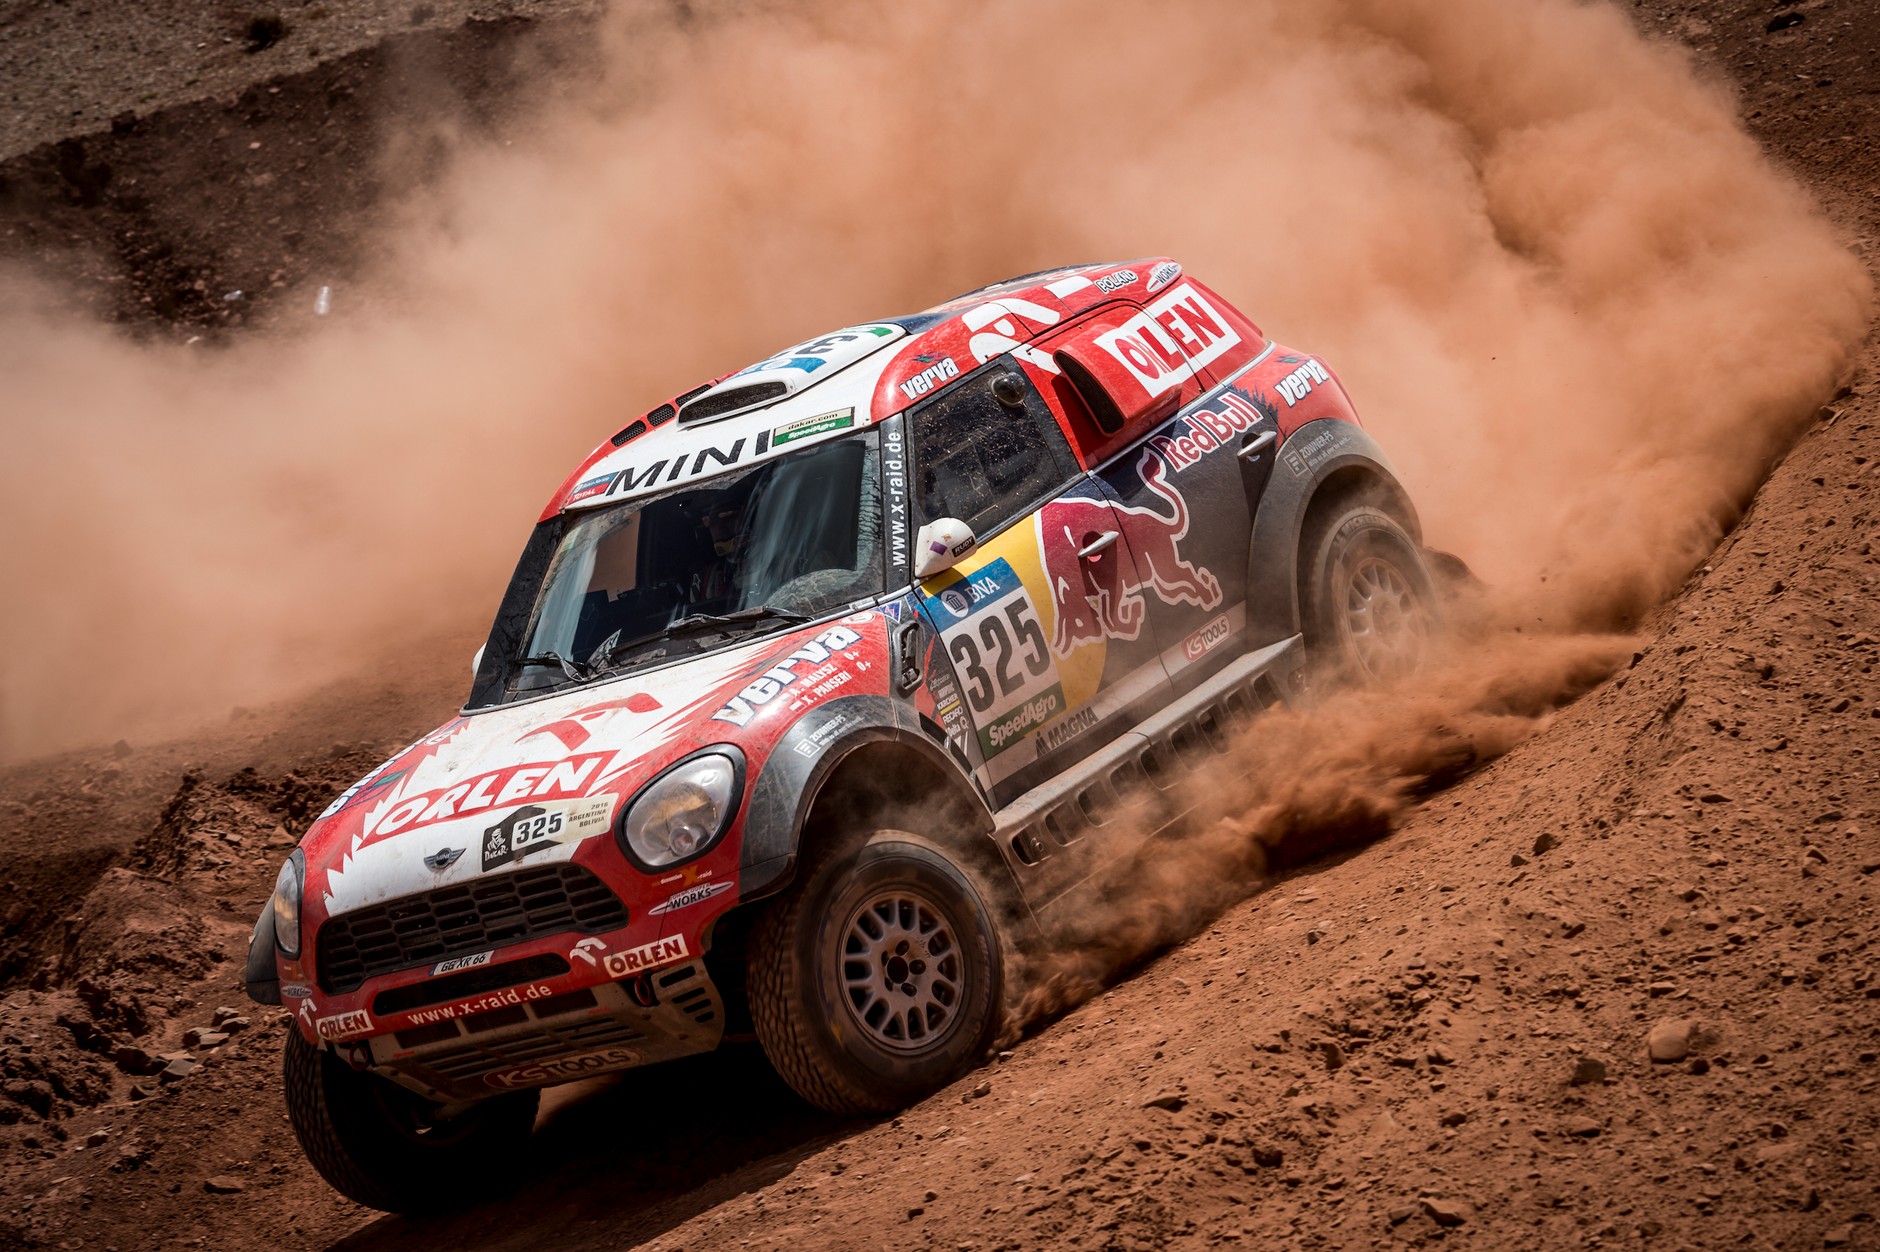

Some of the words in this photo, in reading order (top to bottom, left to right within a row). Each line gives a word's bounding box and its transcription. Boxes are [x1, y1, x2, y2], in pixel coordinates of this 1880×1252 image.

[1095, 270, 1138, 293] POLAND
[899, 358, 960, 400] verva
[1274, 358, 1330, 408] verva
[788, 414, 838, 431] dakar.com
[788, 422, 836, 439] SpeedAgro
[1152, 415, 1215, 472] Red
[1200, 392, 1264, 444] Bull
[606, 430, 771, 496] MINI
[573, 489, 596, 501] TOTAL
[885, 431, 906, 566] www.x-raid.de
[954, 538, 974, 555] RUDY
[965, 576, 1000, 603] BNA
[950, 597, 1051, 713] 325
[711, 625, 863, 729] verva
[800, 663, 838, 688] MALYSZ
[801, 694, 818, 705] X.
[813, 670, 852, 697] PANSERI
[988, 695, 1056, 747] SpeedAgro
[1049, 706, 1100, 748] MAGNA
[376, 757, 600, 835] ORLEN
[516, 813, 563, 843] 325
[568, 809, 607, 823] ARGENTINA
[579, 817, 605, 828] BOLIVIA
[670, 888, 712, 909] WORKS
[457, 956, 473, 969] XR
[471, 953, 486, 965] 66
[609, 939, 681, 973] ORLEN
[408, 984, 552, 1025] www.x-raid.de
[319, 1010, 370, 1039] ORLEN
